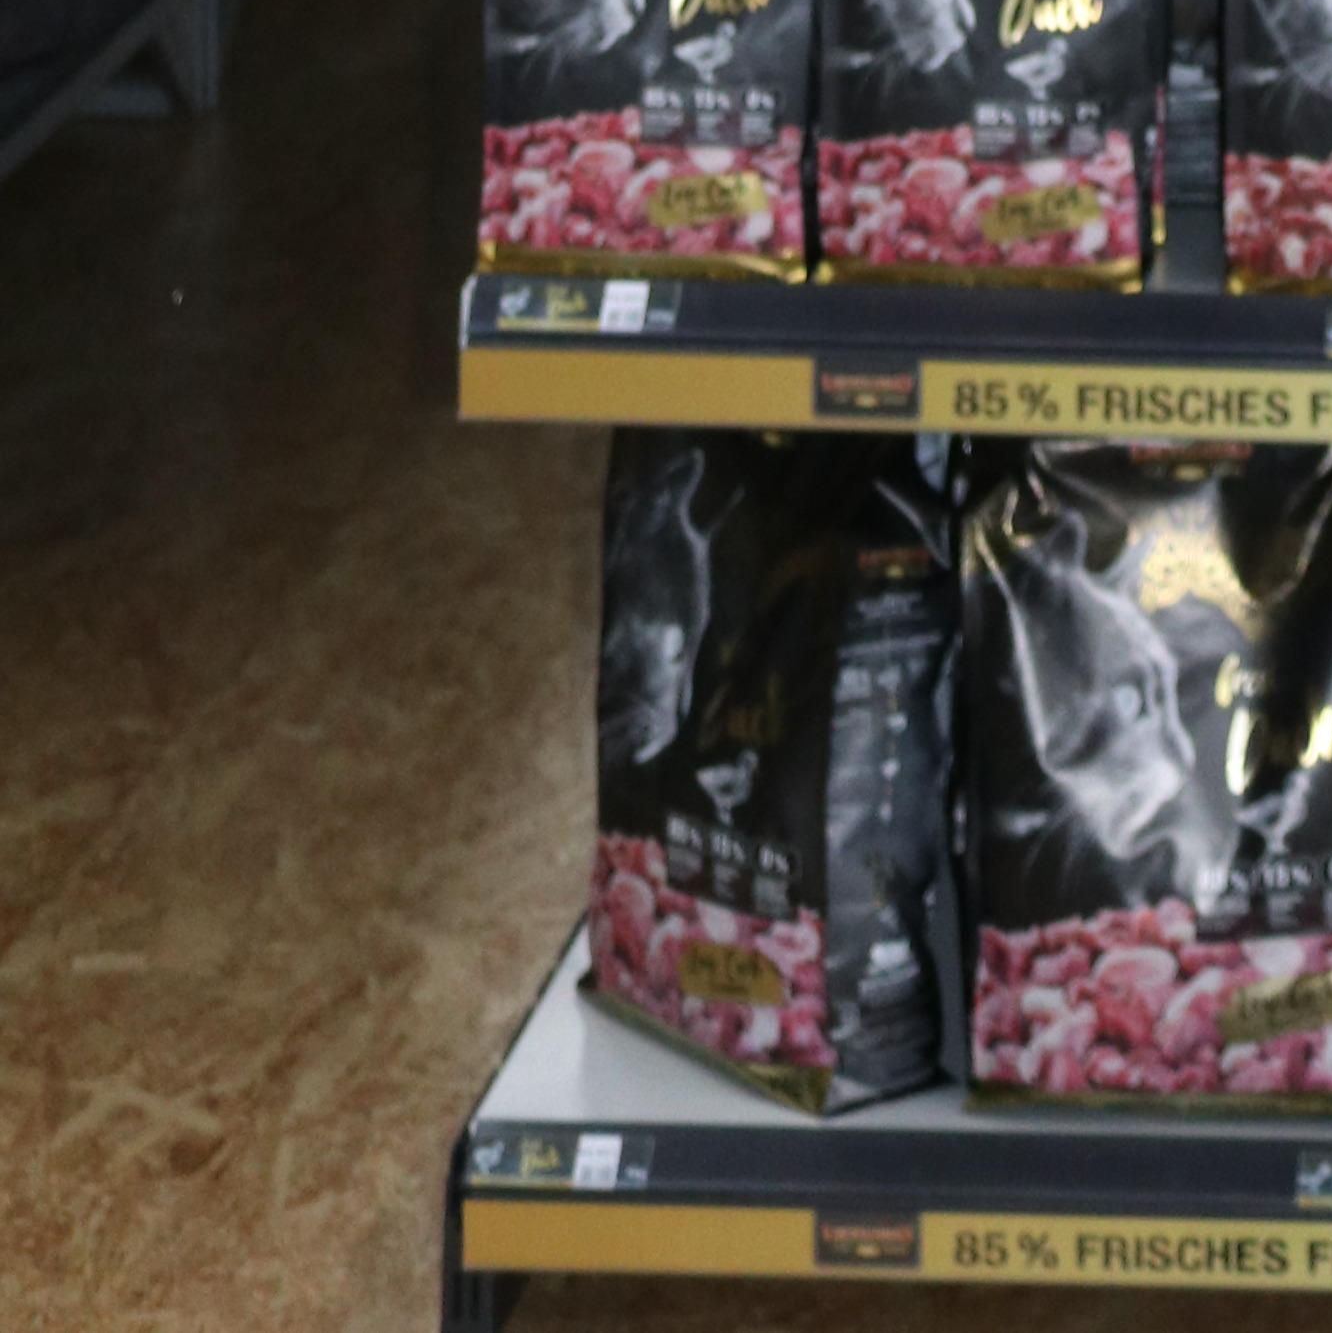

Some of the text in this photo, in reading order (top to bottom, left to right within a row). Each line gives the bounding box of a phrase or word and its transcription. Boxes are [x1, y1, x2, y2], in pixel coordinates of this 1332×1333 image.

[954, 381, 1009, 421] 85
[1077, 384, 1293, 428] FRISCHES
[954, 1230, 1009, 1269] 85
[1076, 1233, 1291, 1276] FRISCHES
